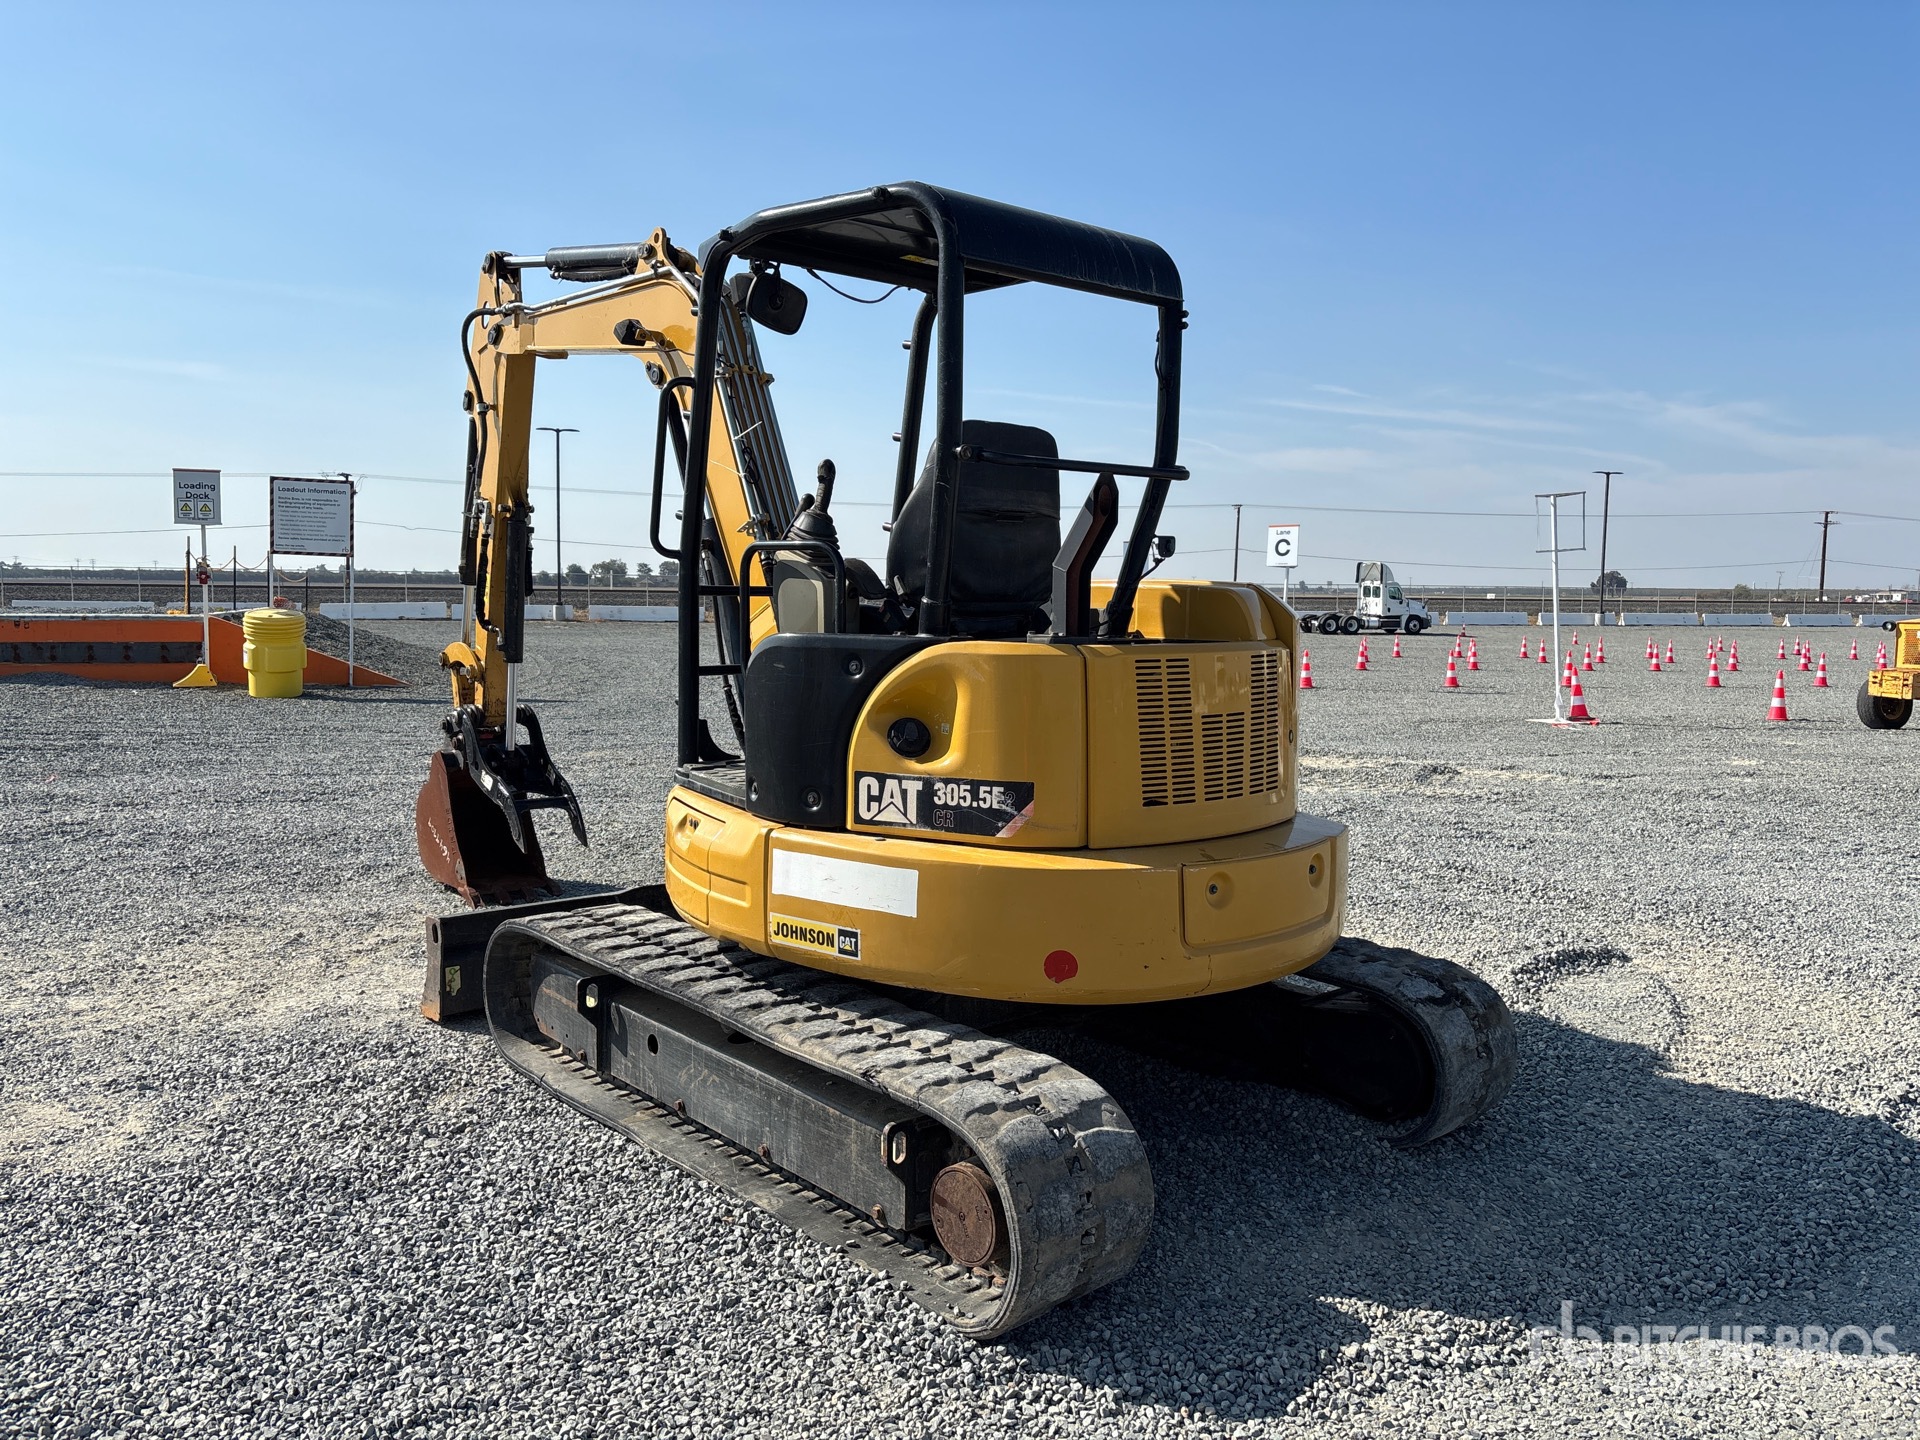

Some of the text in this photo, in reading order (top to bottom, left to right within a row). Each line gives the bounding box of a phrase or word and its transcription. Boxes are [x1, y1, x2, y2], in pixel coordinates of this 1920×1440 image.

[178, 481, 216, 492] Loading
[185, 491, 211, 500] Dock
[307, 487, 347, 496] Information
[1275, 538, 1291, 557] C
[858, 776, 923, 825] CAT
[932, 809, 954, 828] CR
[773, 921, 856, 952] JOHNSON CAT
